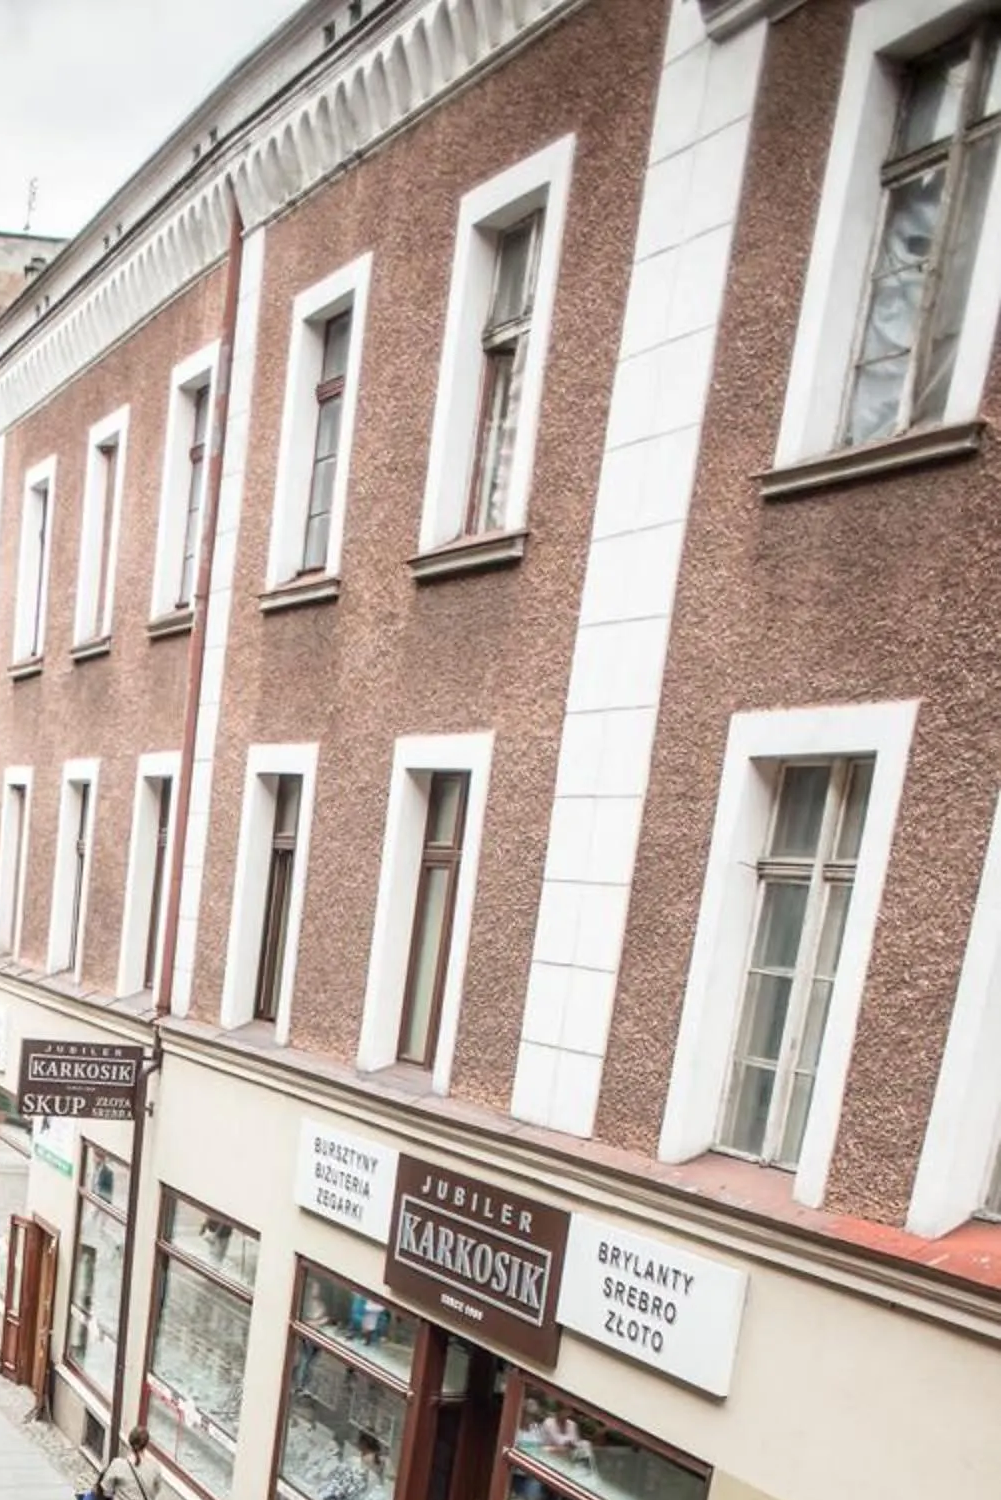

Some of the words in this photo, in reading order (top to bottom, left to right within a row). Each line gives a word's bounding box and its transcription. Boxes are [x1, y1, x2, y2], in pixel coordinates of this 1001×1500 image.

[32, 1060, 131, 1081] KARKOSIK
[44, 1045, 122, 1056] JUBILER
[22, 1093, 86, 1115] SKUP
[314, 1136, 379, 1175] BURSZTYNY
[316, 1187, 364, 1219] ZEGARKI
[421, 1175, 533, 1234] JUBILER
[401, 1211, 544, 1309] KARKOSIK
[598, 1242, 695, 1295] BRYLANTY
[602, 1277, 677, 1325] SREBRO
[604, 1310, 664, 1353] ZŁOTO
